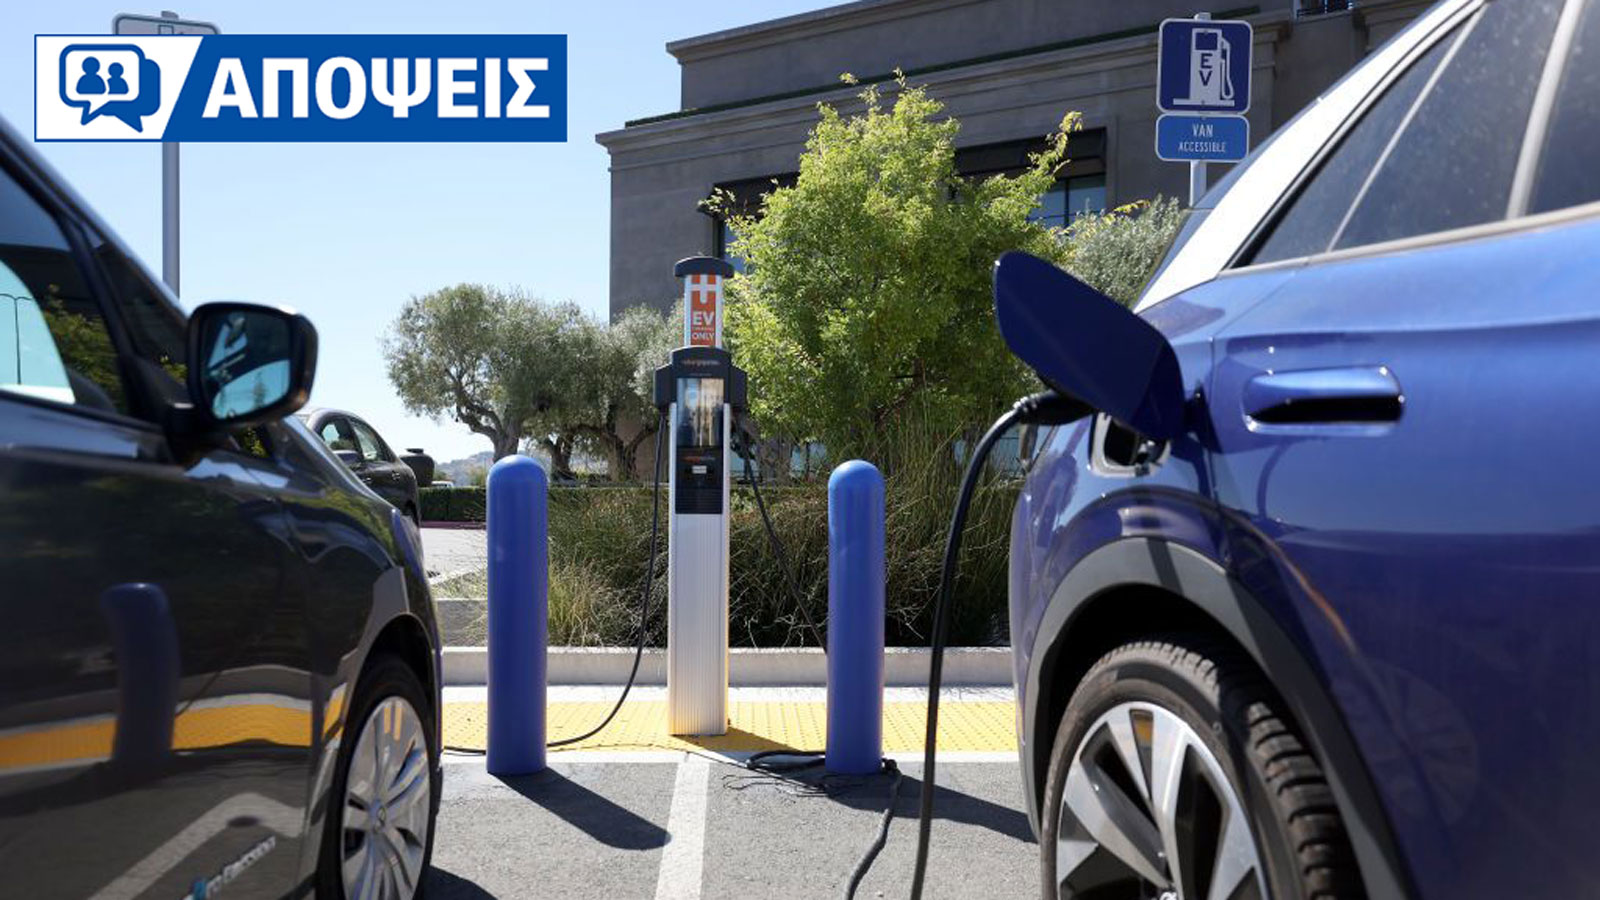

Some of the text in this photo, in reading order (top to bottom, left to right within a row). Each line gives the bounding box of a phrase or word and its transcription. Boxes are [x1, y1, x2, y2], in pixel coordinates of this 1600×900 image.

[1192, 123, 1214, 137] VAN
[1178, 142, 1226, 152] ACCESSIBLE
[693, 311, 715, 326] EV
[692, 332, 715, 341] ONLY
